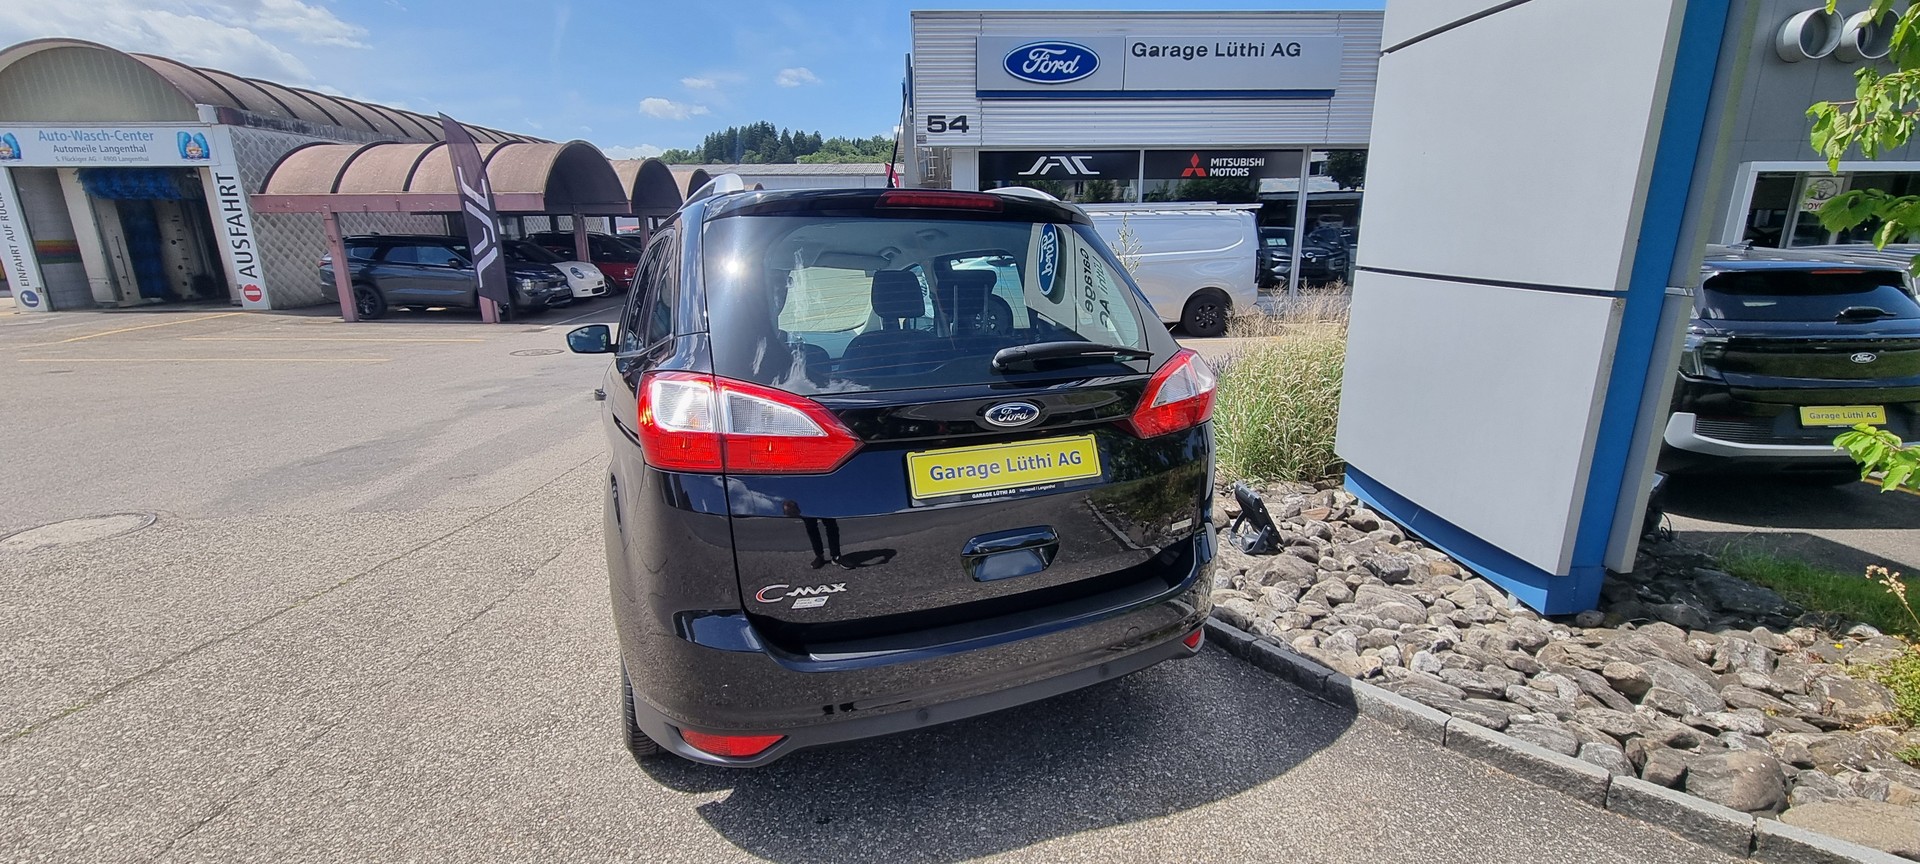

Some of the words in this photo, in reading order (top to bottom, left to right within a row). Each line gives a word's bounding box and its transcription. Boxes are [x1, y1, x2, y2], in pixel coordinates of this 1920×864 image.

[1131, 42, 1208, 61] Garage
[1215, 41, 1265, 57] Lüthi
[1270, 42, 1302, 57] AG
[1022, 48, 1081, 74] Ford
[927, 115, 970, 133] 54
[38, 130, 154, 142] Auto-Wasch-Center
[53, 145, 97, 153] Automeile
[99, 144, 147, 154] Langenthal
[1018, 156, 1100, 175] JAC
[1209, 167, 1250, 177] MOTORS
[1210, 158, 1265, 167] MITSUBISHI
[2, 223, 15, 242] AUF
[215, 172, 258, 279] AUSFAHRT
[8, 244, 30, 287] EINFAHRT
[998, 406, 1029, 421] Ford
[1809, 412, 1840, 420] Garage
[930, 462, 1001, 481] Garage
[1006, 453, 1053, 473] Lüthi
[1058, 450, 1082, 466] AG
[755, 582, 848, 603] C-MAX
